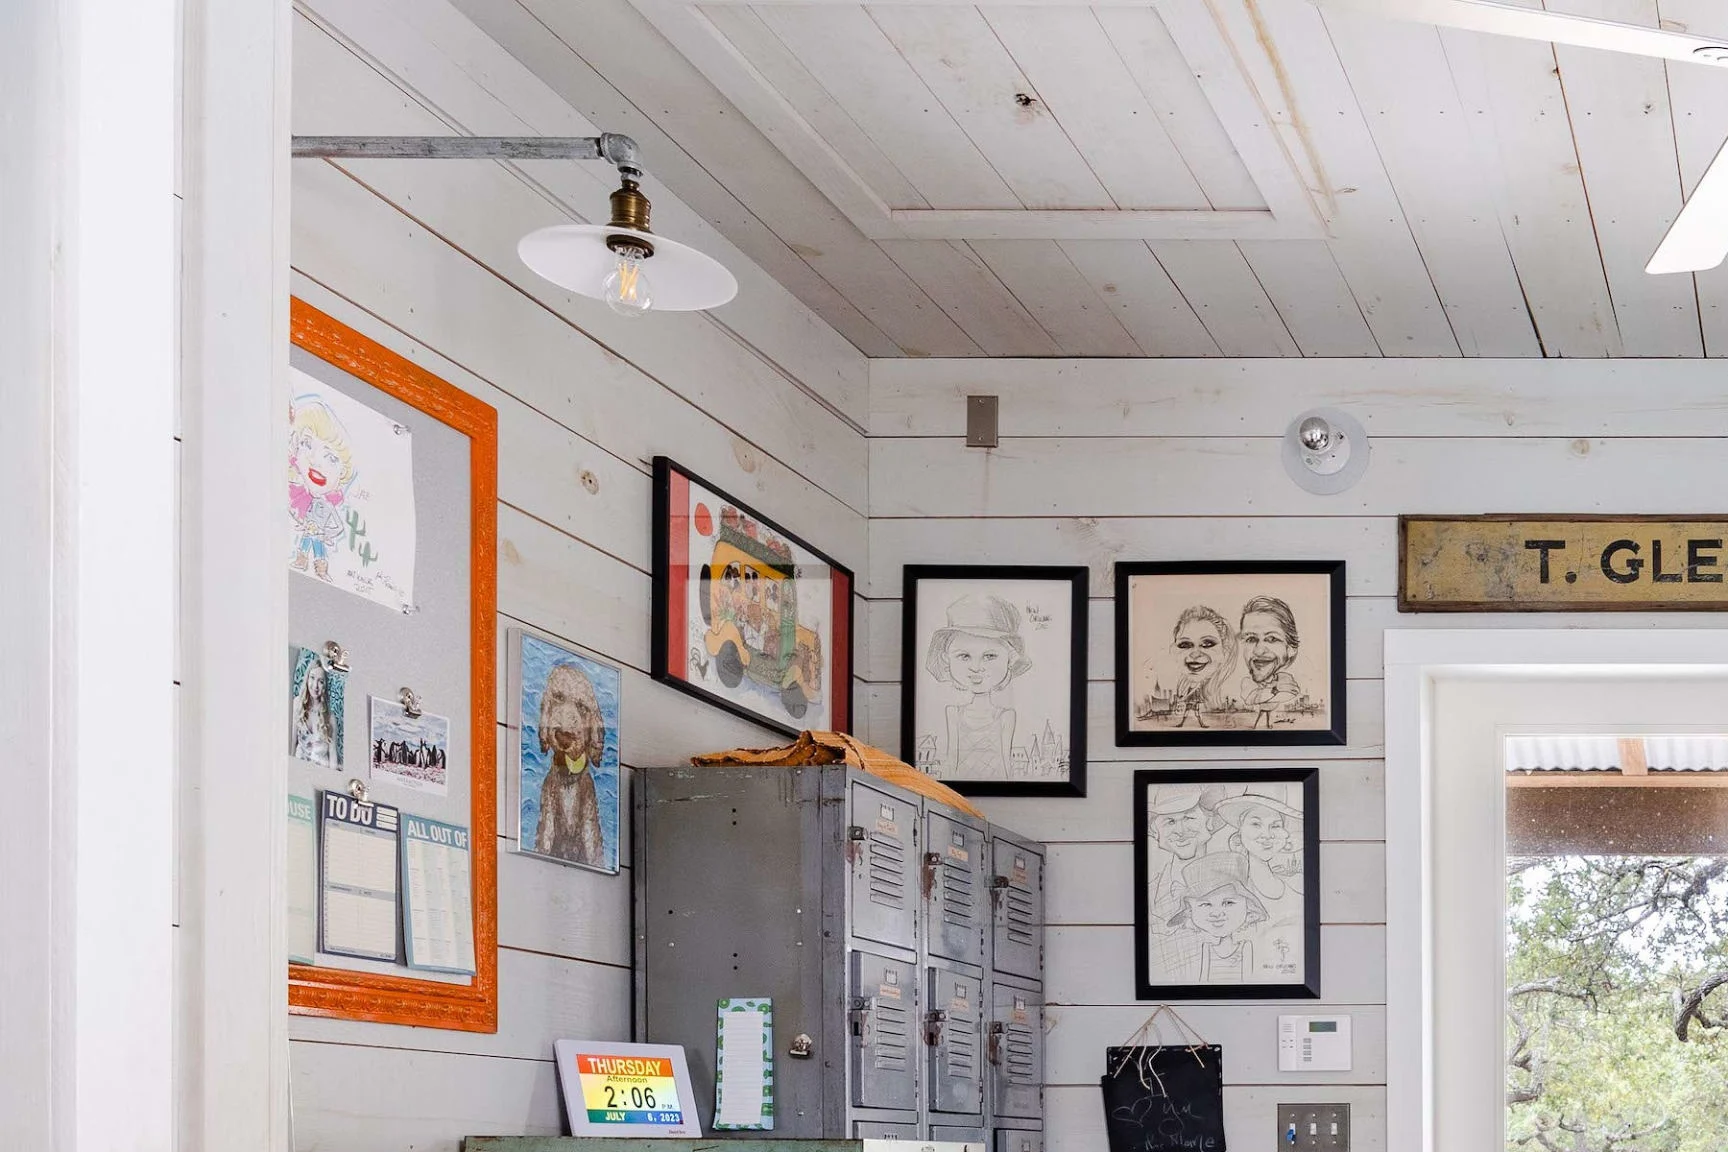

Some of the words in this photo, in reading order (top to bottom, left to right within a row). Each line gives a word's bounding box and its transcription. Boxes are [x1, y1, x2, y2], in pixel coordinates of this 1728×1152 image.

[1525, 540, 1577, 584] T.
[287, 800, 311, 820] USE
[327, 795, 346, 819] TO
[350, 801, 373, 825] DO
[408, 820, 428, 839] ALL
[430, 825, 452, 844] OUT
[454, 831, 468, 847] OF
[587, 1058, 661, 1075] THURSDAY
[604, 1086, 656, 1108] 2:06
[605, 1112, 627, 1121] JULY
[660, 1113, 680, 1122] 2023
